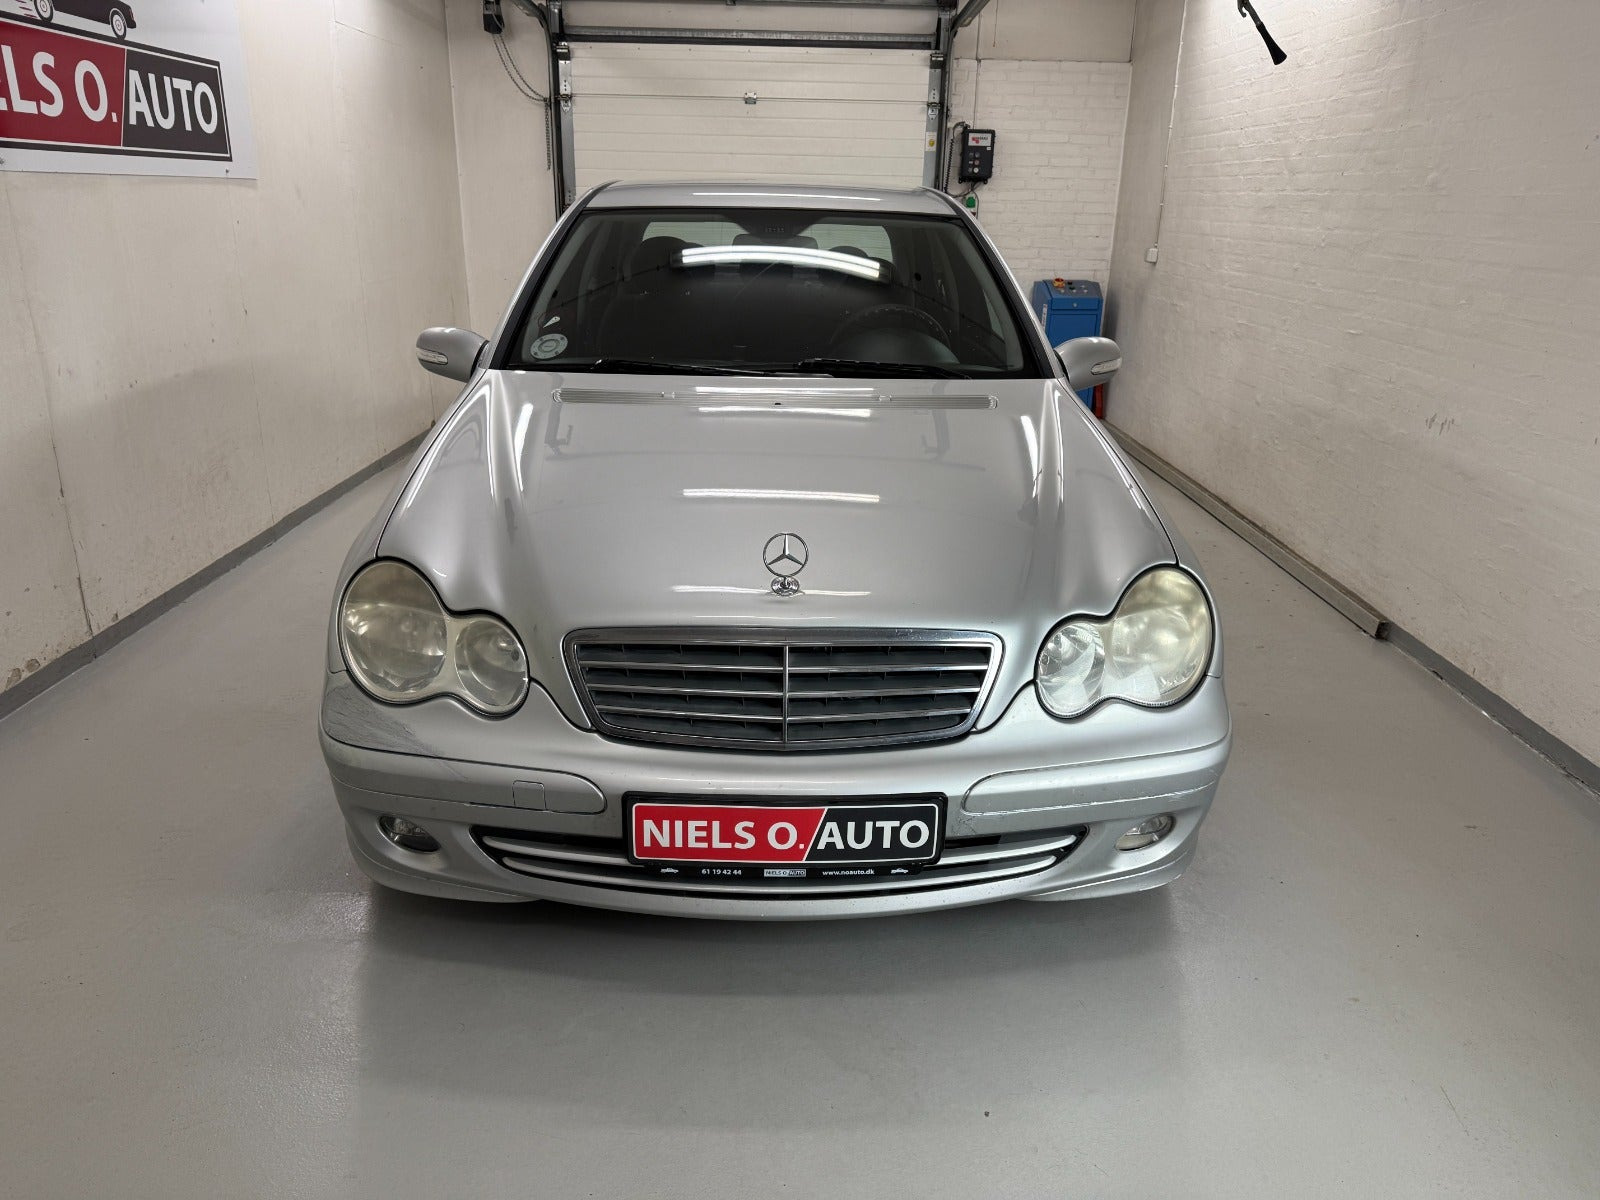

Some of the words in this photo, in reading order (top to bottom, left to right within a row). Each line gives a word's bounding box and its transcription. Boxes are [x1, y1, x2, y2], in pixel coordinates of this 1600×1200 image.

[74, 59, 118, 123] O.
[128, 69, 218, 134] AUTO
[642, 819, 756, 849] NIELS
[767, 821, 805, 849] O.
[816, 819, 930, 849] AUTO
